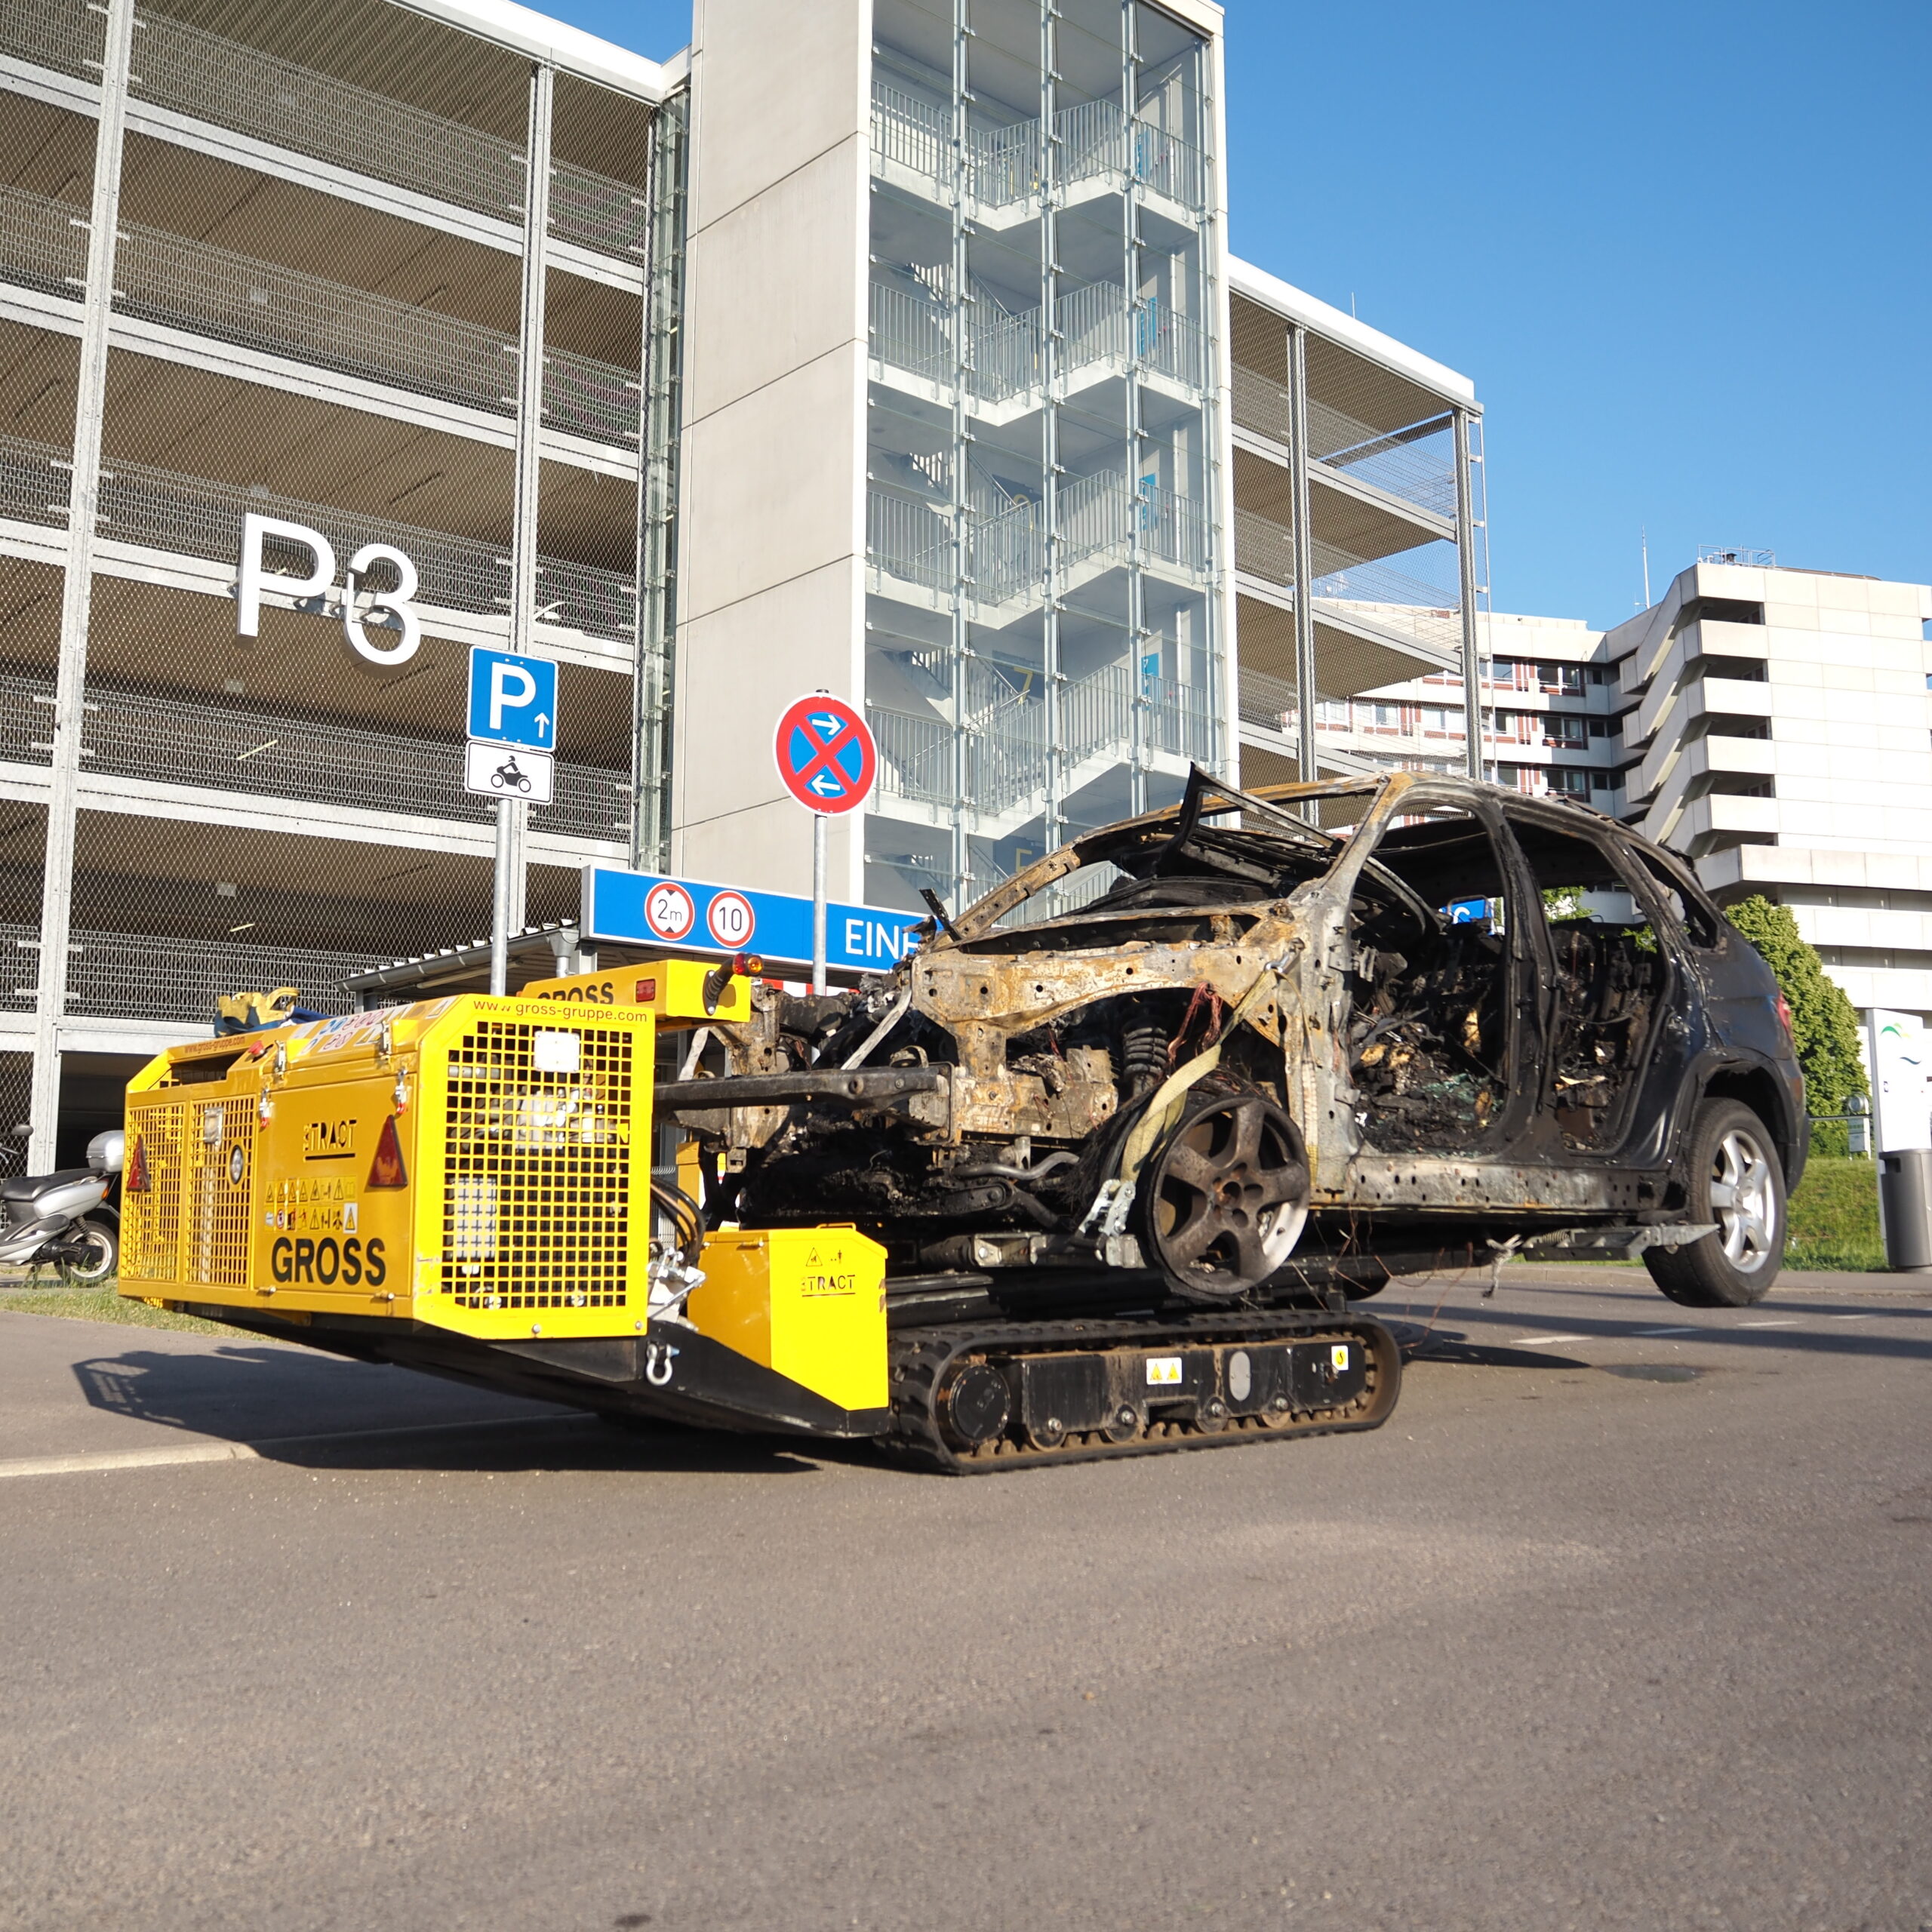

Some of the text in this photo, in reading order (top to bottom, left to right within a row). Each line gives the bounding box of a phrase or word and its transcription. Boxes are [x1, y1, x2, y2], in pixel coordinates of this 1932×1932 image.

[237, 512, 421, 666] P3
[489, 661, 537, 730] P
[718, 906, 743, 932] 10
[473, 1000, 648, 1023] wwgross-gruppe.com
[537, 982, 614, 1005] OSS
[272, 1236, 386, 1287] GROSS
